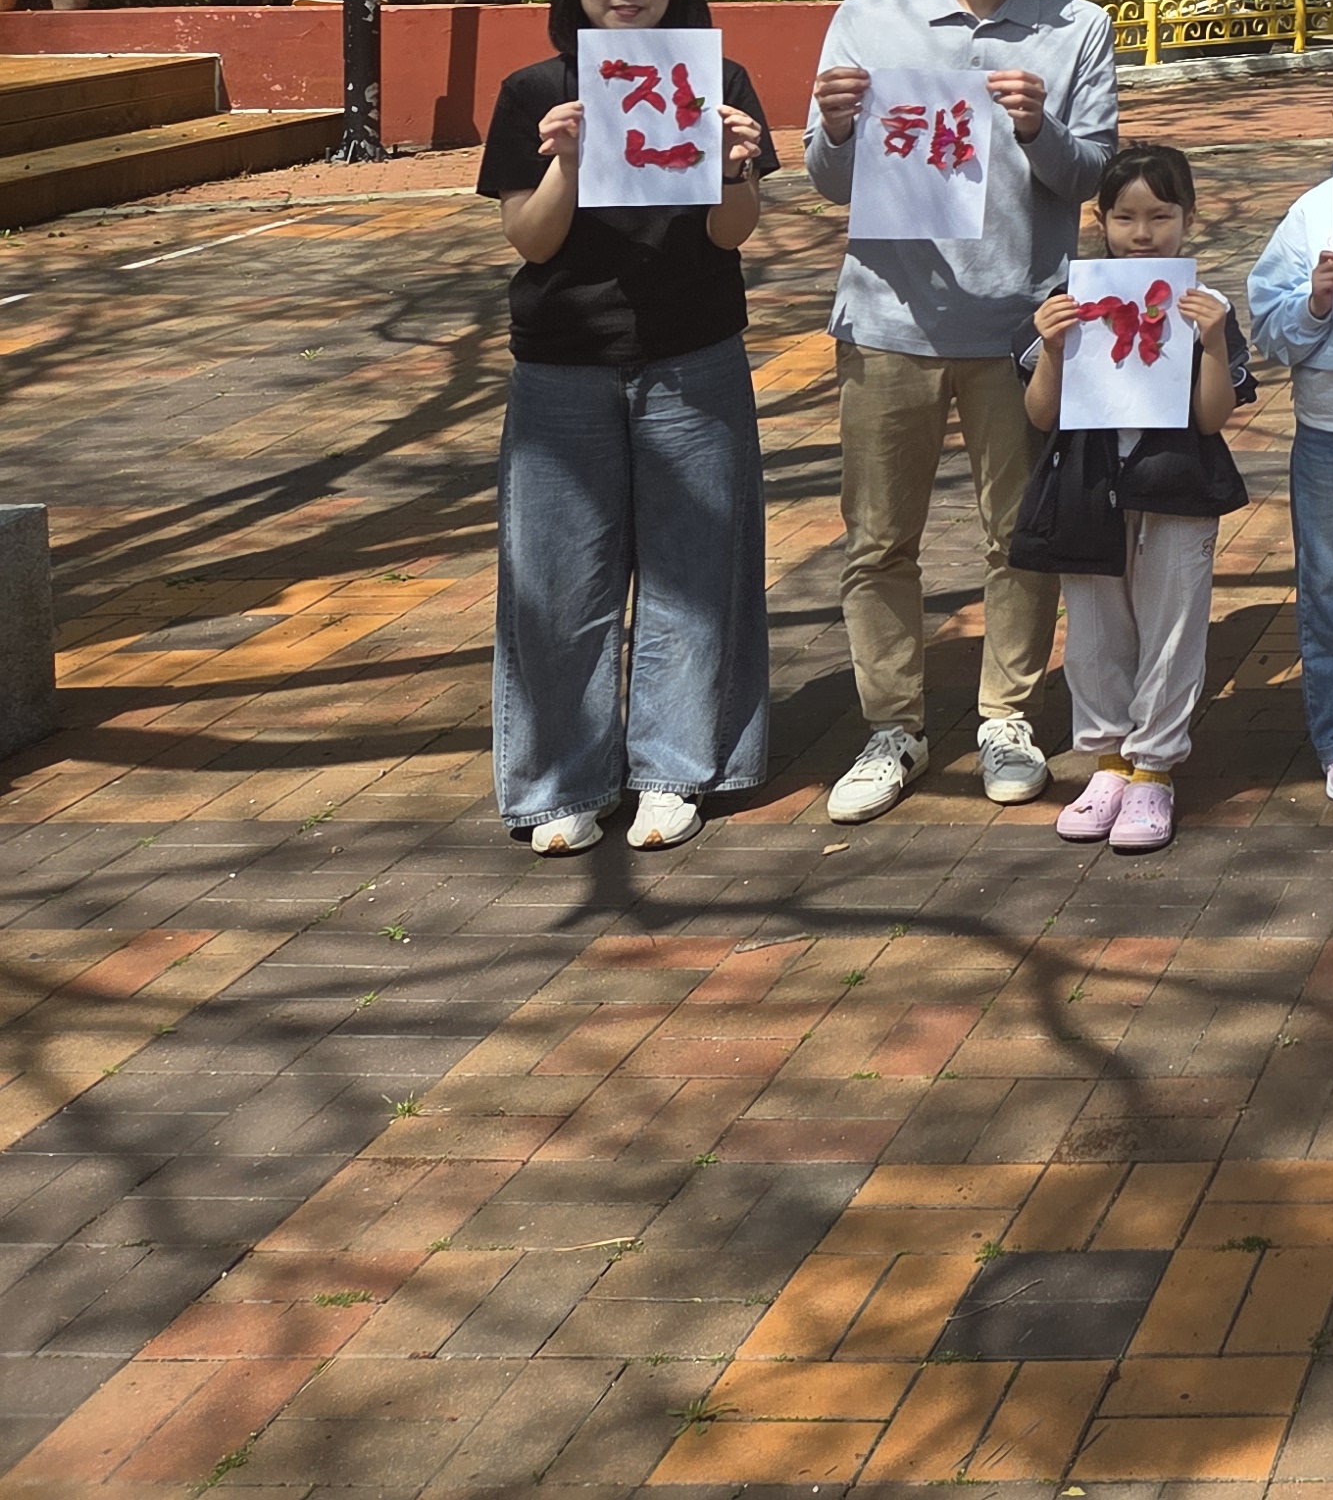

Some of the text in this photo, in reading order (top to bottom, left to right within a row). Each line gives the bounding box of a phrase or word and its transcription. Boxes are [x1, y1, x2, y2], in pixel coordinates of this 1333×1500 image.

[598, 58, 706, 169] 진
[879, 99, 975, 171] 해
[1076, 279, 1173, 367] 기
